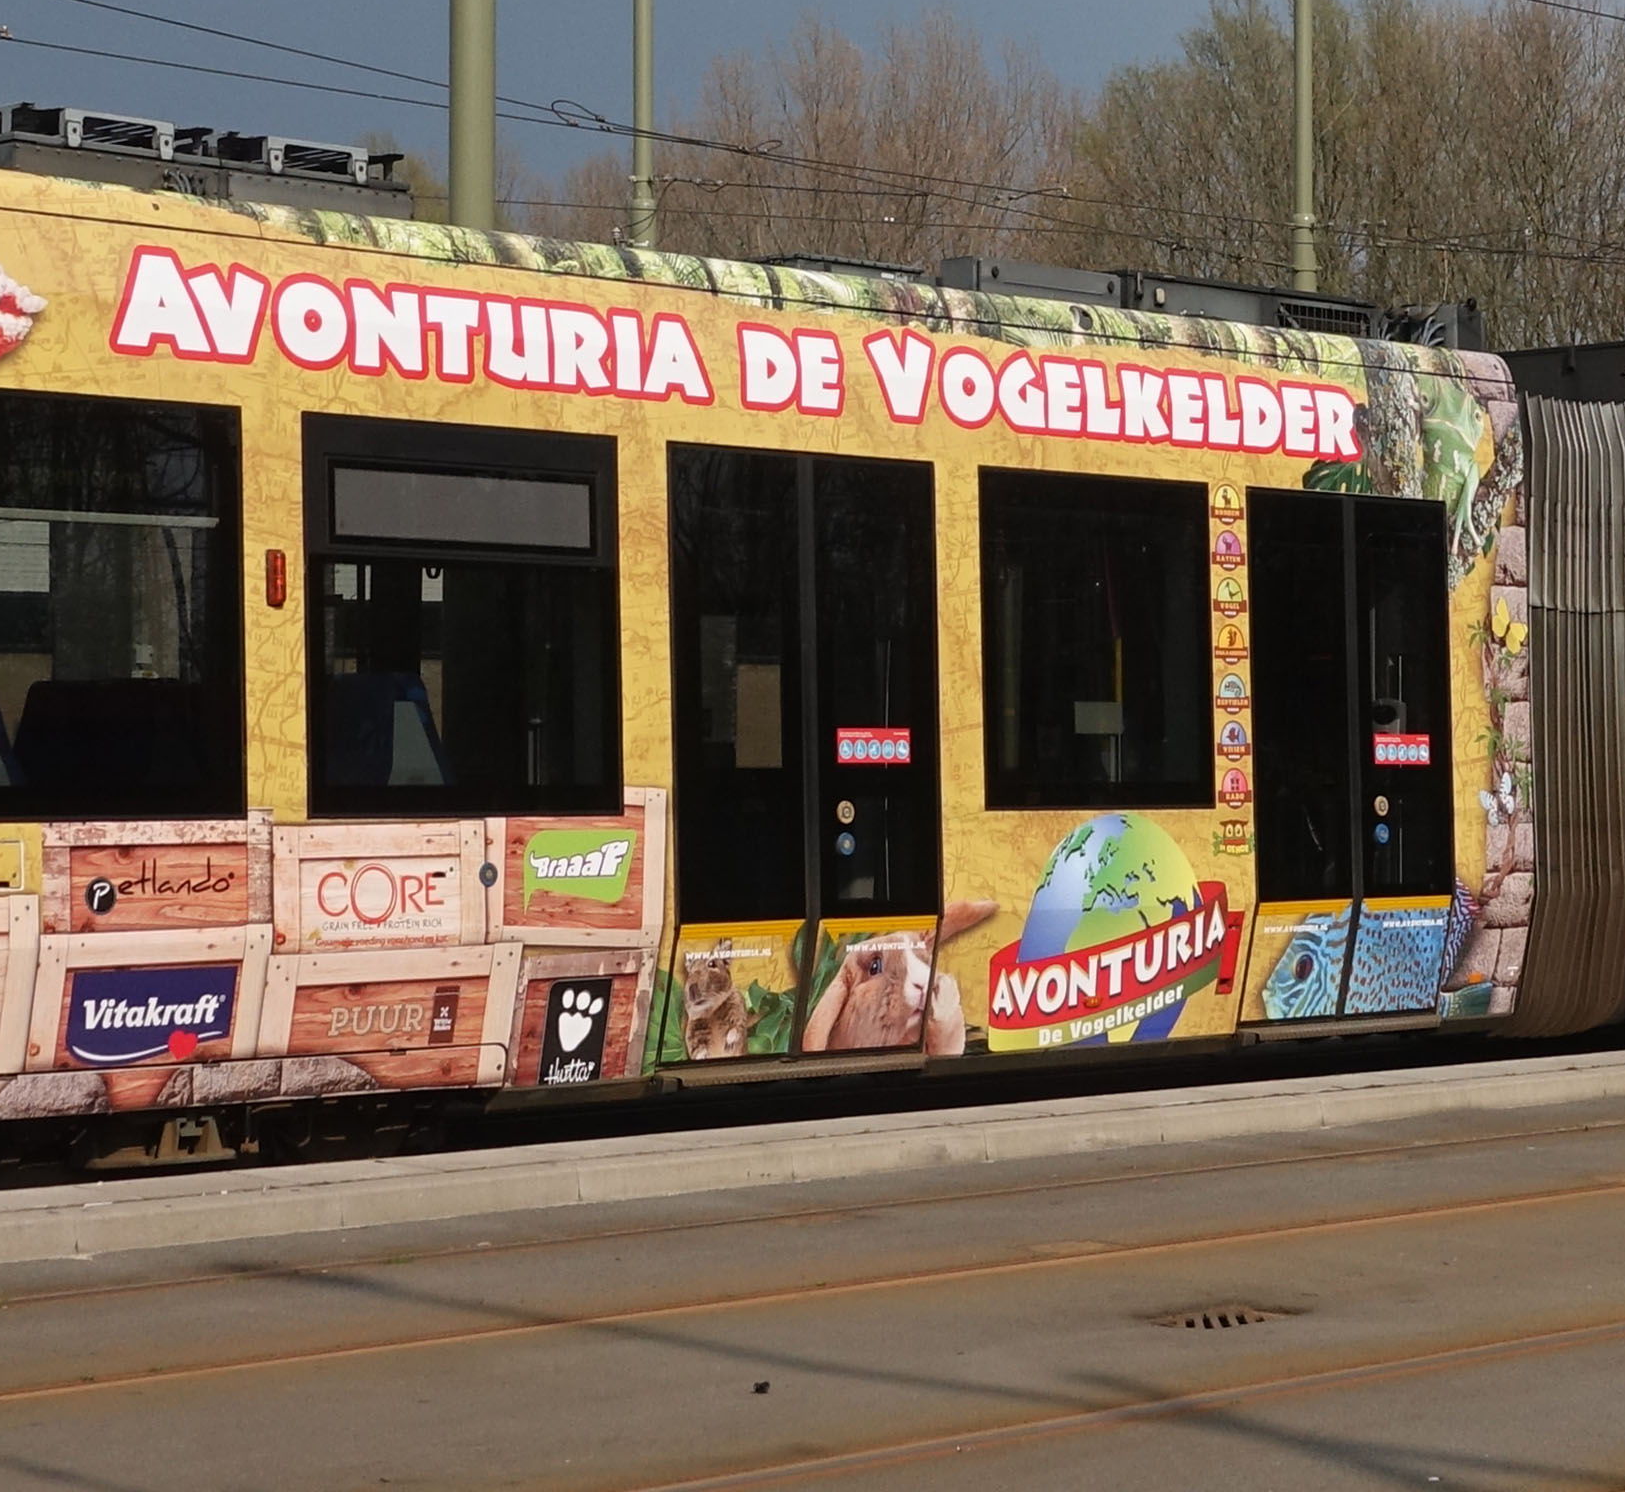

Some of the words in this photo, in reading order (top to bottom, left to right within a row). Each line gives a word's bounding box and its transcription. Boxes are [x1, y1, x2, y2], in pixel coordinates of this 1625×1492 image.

[114, 250, 712, 401] AVONTURIA
[740, 325, 843, 414] DE
[867, 332, 1361, 459] VOGELKELDER
[89, 856, 231, 913] Petlando
[317, 862, 445, 925] CORE
[992, 901, 1226, 1016] AVONTURIA
[83, 993, 220, 1031] Vitakraft
[327, 1003, 424, 1037] PUUR
[1038, 1026, 1063, 1047] De
[1069, 983, 1185, 1038] Vogelkelder
